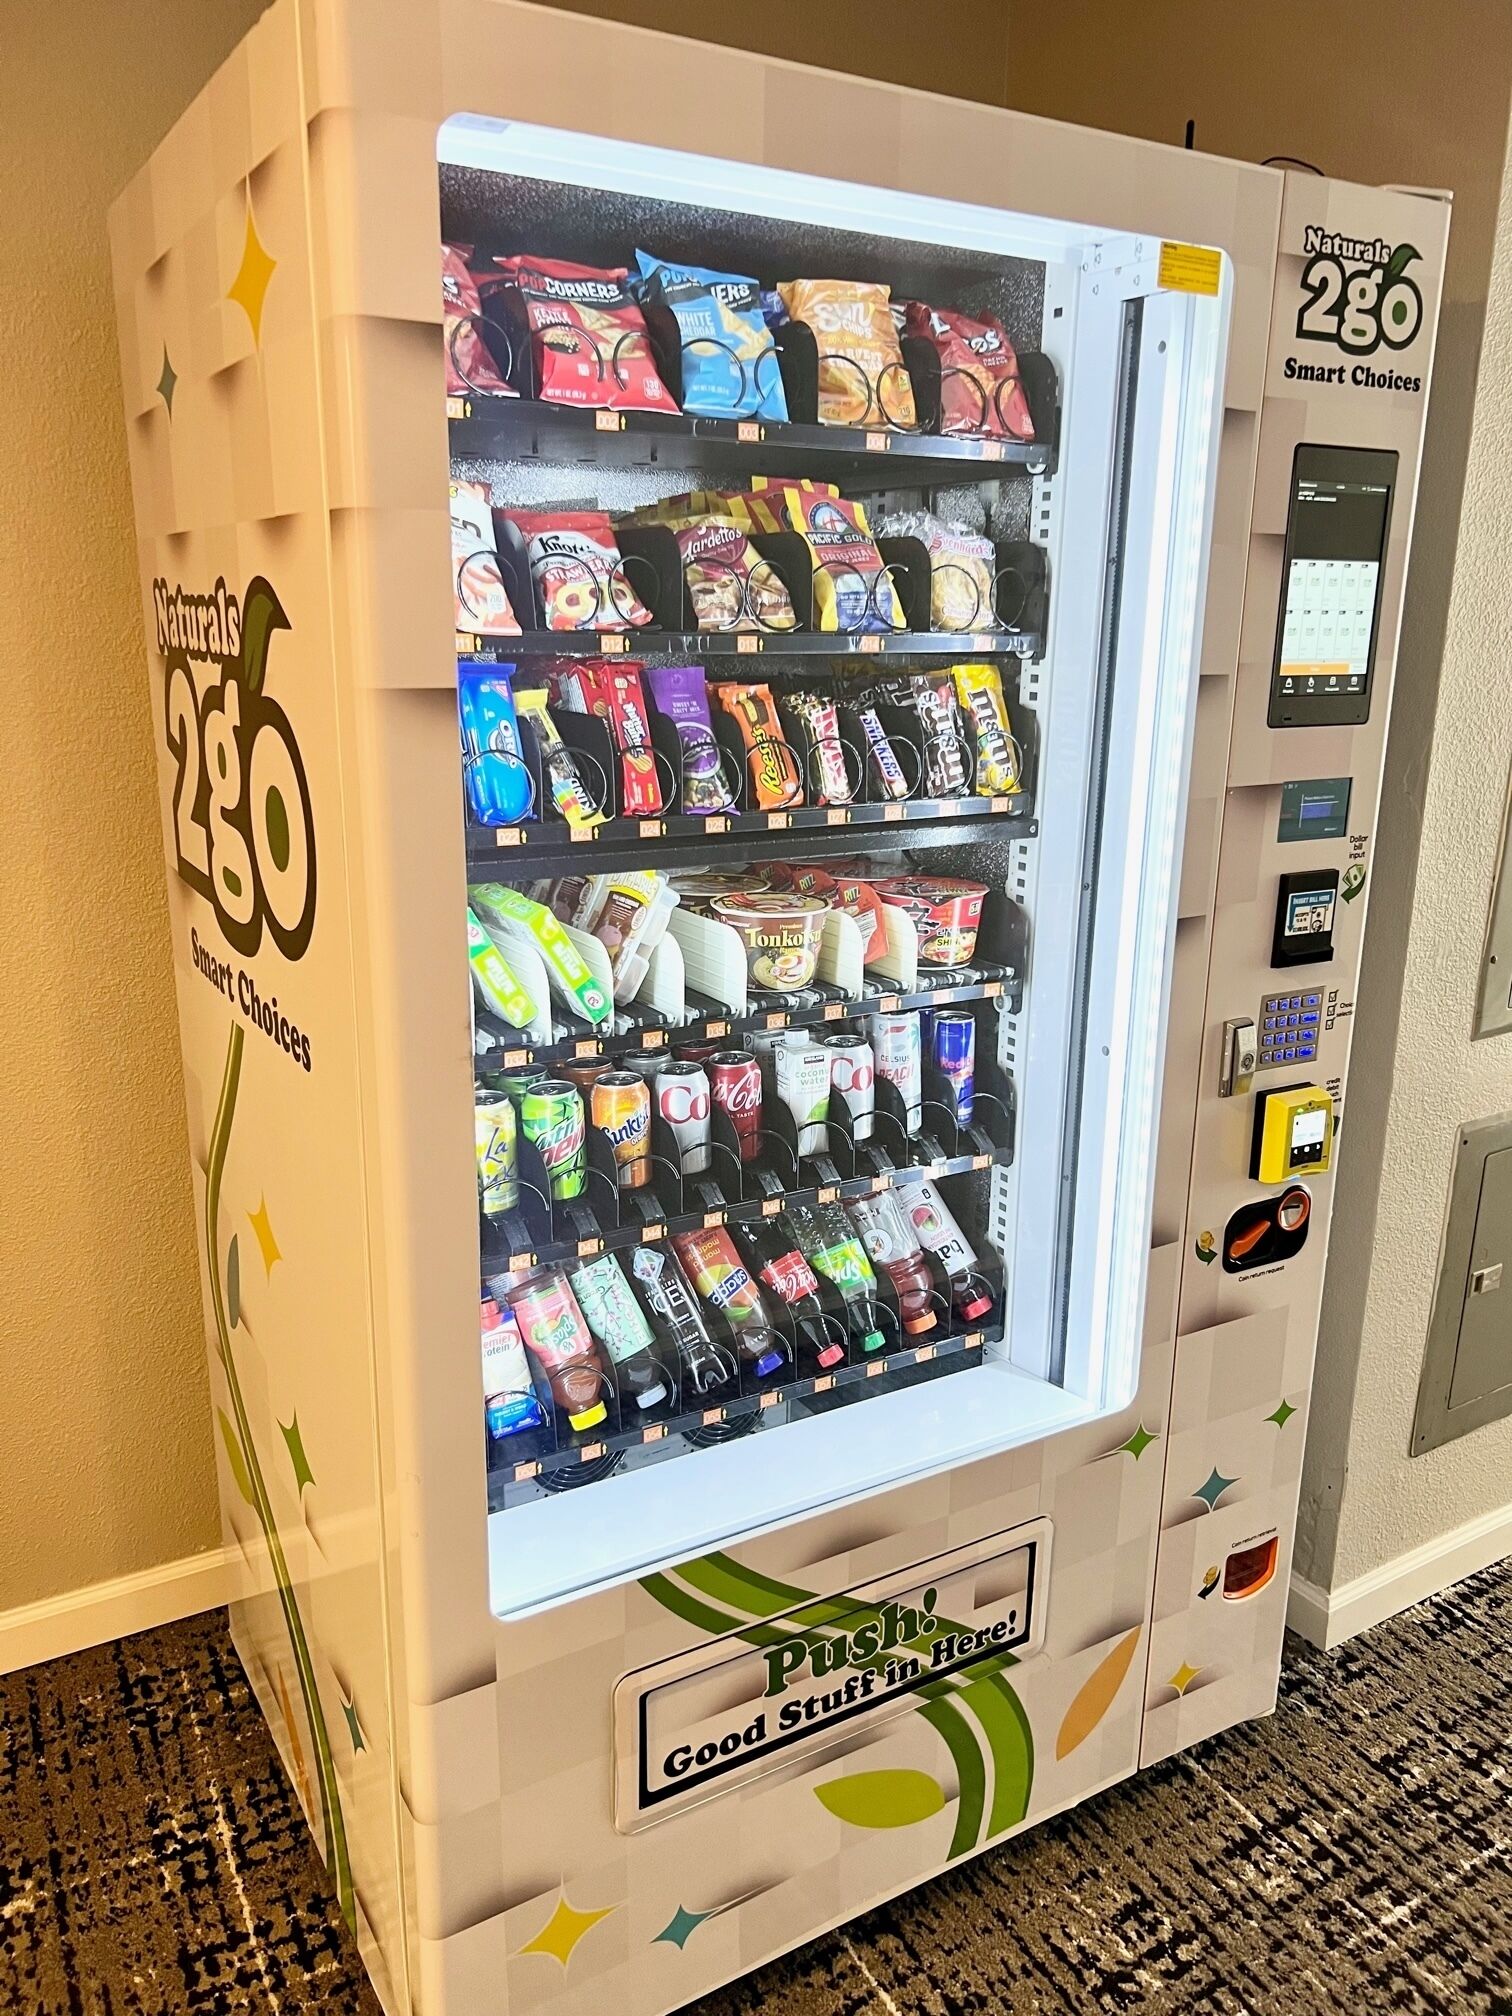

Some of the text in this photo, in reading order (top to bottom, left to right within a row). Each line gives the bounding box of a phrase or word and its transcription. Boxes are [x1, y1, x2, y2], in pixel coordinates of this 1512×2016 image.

[1304, 225, 1391, 265] Naturals
[1284, 357, 1421, 392] Smart Choices
[807, 533, 842, 545] PACIFIC
[821, 549, 876, 562] ORIGINAL
[153, 577, 241, 662] Naturals
[602, 638, 622, 651] 012
[738, 638, 757, 651] 013
[1350, 835, 1368, 843] Dollar
[1349, 851, 1365, 860] input
[799, 873, 817, 890] RITZ
[844, 886, 860, 903] RITZ
[191, 926, 311, 1073] Smart Choices
[708, 1025, 724, 1036] 035
[485, 1127, 509, 1164] La
[764, 1201, 779, 1212] 046
[705, 1214, 722, 1225] 045
[484, 1343, 510, 1357] otein
[762, 1587, 938, 1699] Push!
[663, 1609, 1017, 1779] Good Stuff in Here!
